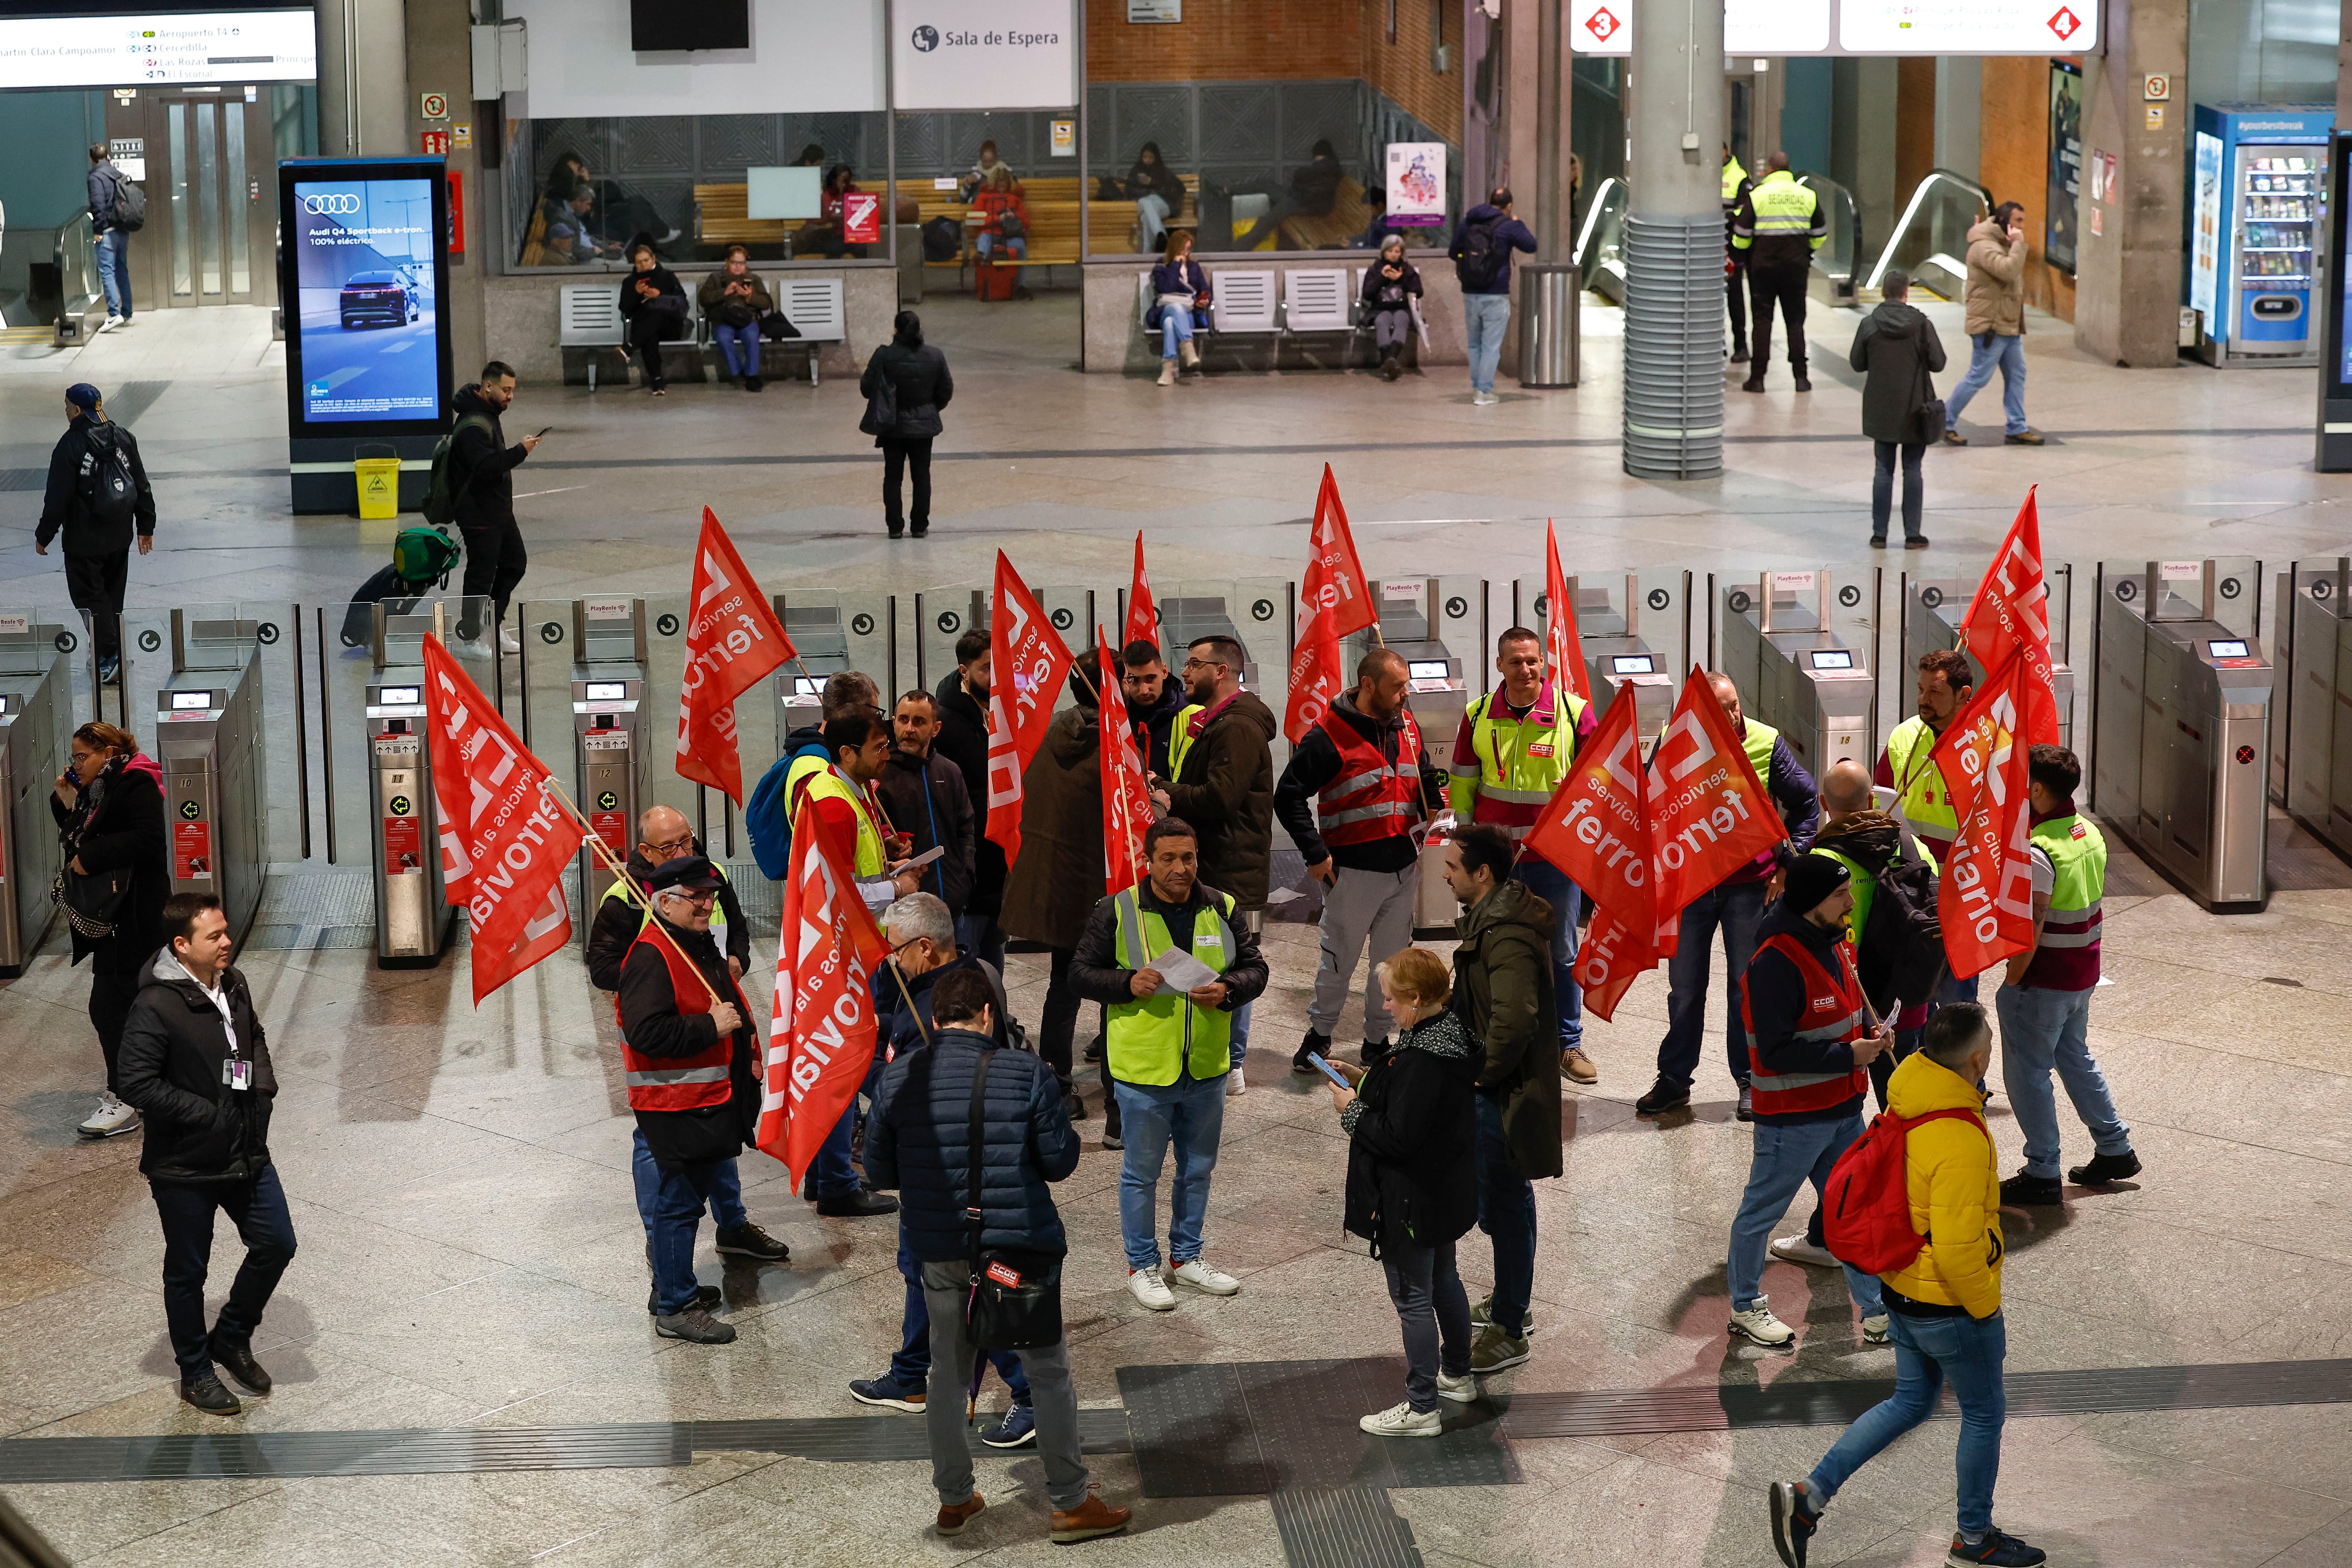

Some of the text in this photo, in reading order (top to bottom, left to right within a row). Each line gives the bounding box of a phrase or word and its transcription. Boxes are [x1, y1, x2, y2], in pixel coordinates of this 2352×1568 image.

[1594, 12, 1612, 36] 3
[2054, 12, 2072, 35] 4
[160, 29, 213, 39] Aeropuerto
[946, 31, 1058, 48] Sala de Espera
[59, 47, 116, 57] Campoamor
[180, 70, 213, 78] Escorial
[309, 228, 330, 236] Audi
[332, 228, 345, 236] Q4
[347, 227, 392, 236] Sportback
[337, 236, 375, 245] eléctrico.
[182, 779, 191, 787] 10
[393, 775, 402, 783] 11
[1813, 996, 1835, 1006] CCOO
[991, 1263, 1018, 1280] CCOO
